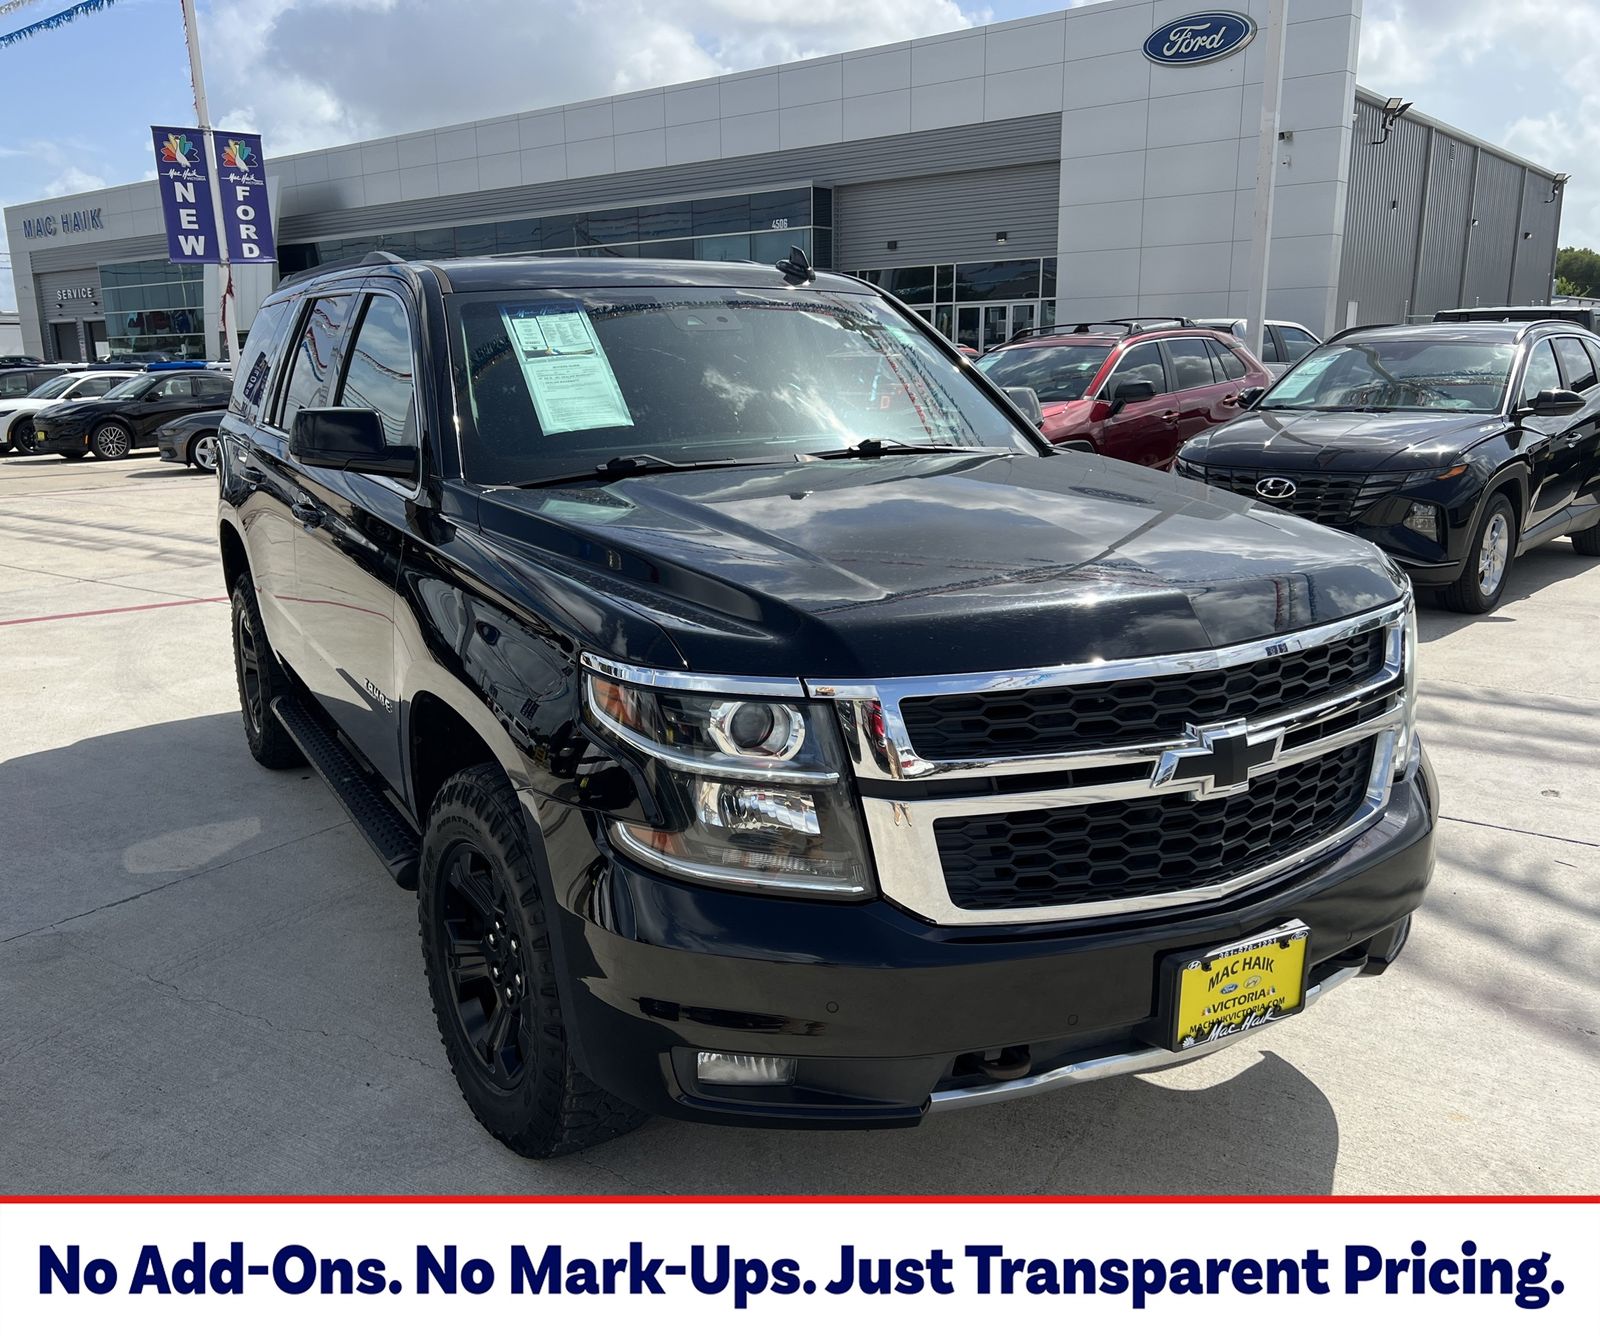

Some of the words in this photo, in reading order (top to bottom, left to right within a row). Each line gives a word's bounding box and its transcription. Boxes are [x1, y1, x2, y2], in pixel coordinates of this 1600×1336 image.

[1163, 23, 1227, 56] Ford
[23, 217, 54, 239] MAC
[61, 209, 102, 233] HAIK
[174, 181, 205, 256] NEW
[235, 185, 260, 258] FORD
[771, 218, 788, 229] 4506
[56, 287, 93, 300] SERVICE
[1208, 961, 1240, 992] MAC
[1242, 956, 1275, 973] HAIK
[1211, 988, 1266, 1014] VICTORIA
[1207, 1021, 1240, 1042] Mac
[1241, 1007, 1277, 1031] Haik
